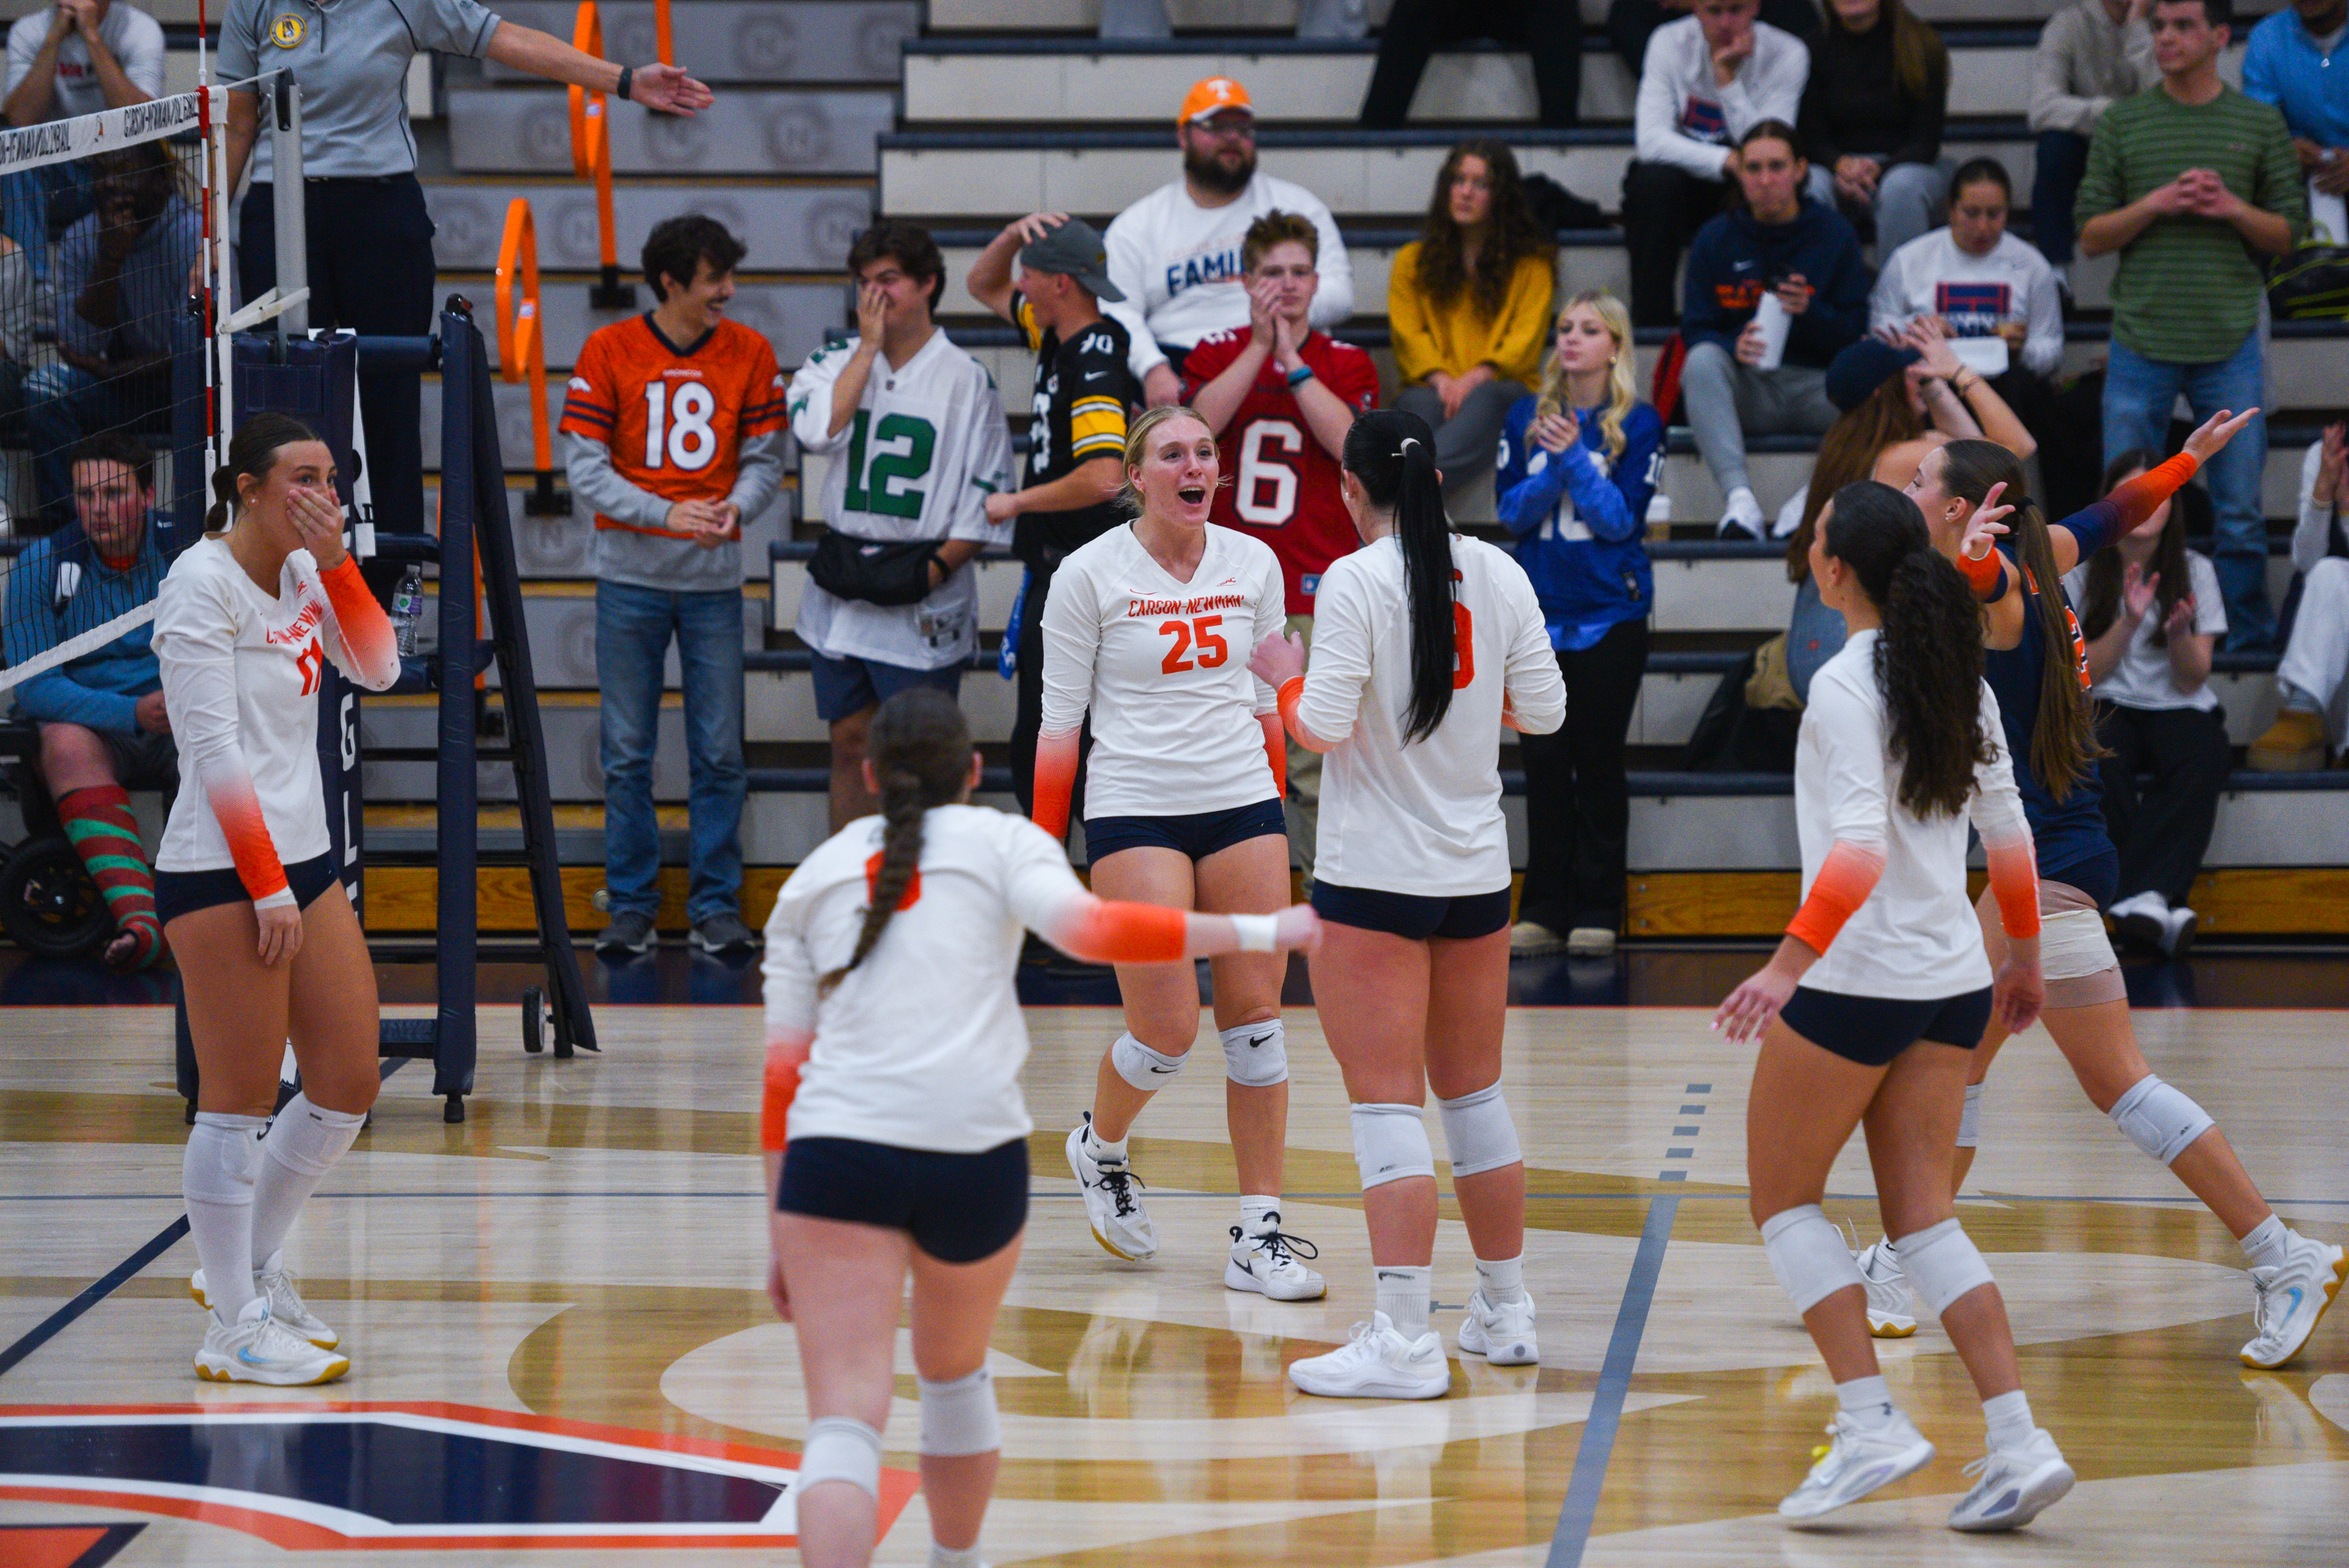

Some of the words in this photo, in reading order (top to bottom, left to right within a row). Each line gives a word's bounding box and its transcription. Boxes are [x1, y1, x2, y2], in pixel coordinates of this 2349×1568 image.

[1205, 79, 1233, 100] T
[644, 380, 717, 471] 18
[843, 408, 937, 520] 12
[1235, 415, 1303, 527] 6
[1127, 594, 1244, 617] CARSON-NEWMAN
[1158, 614, 1228, 675] 25
